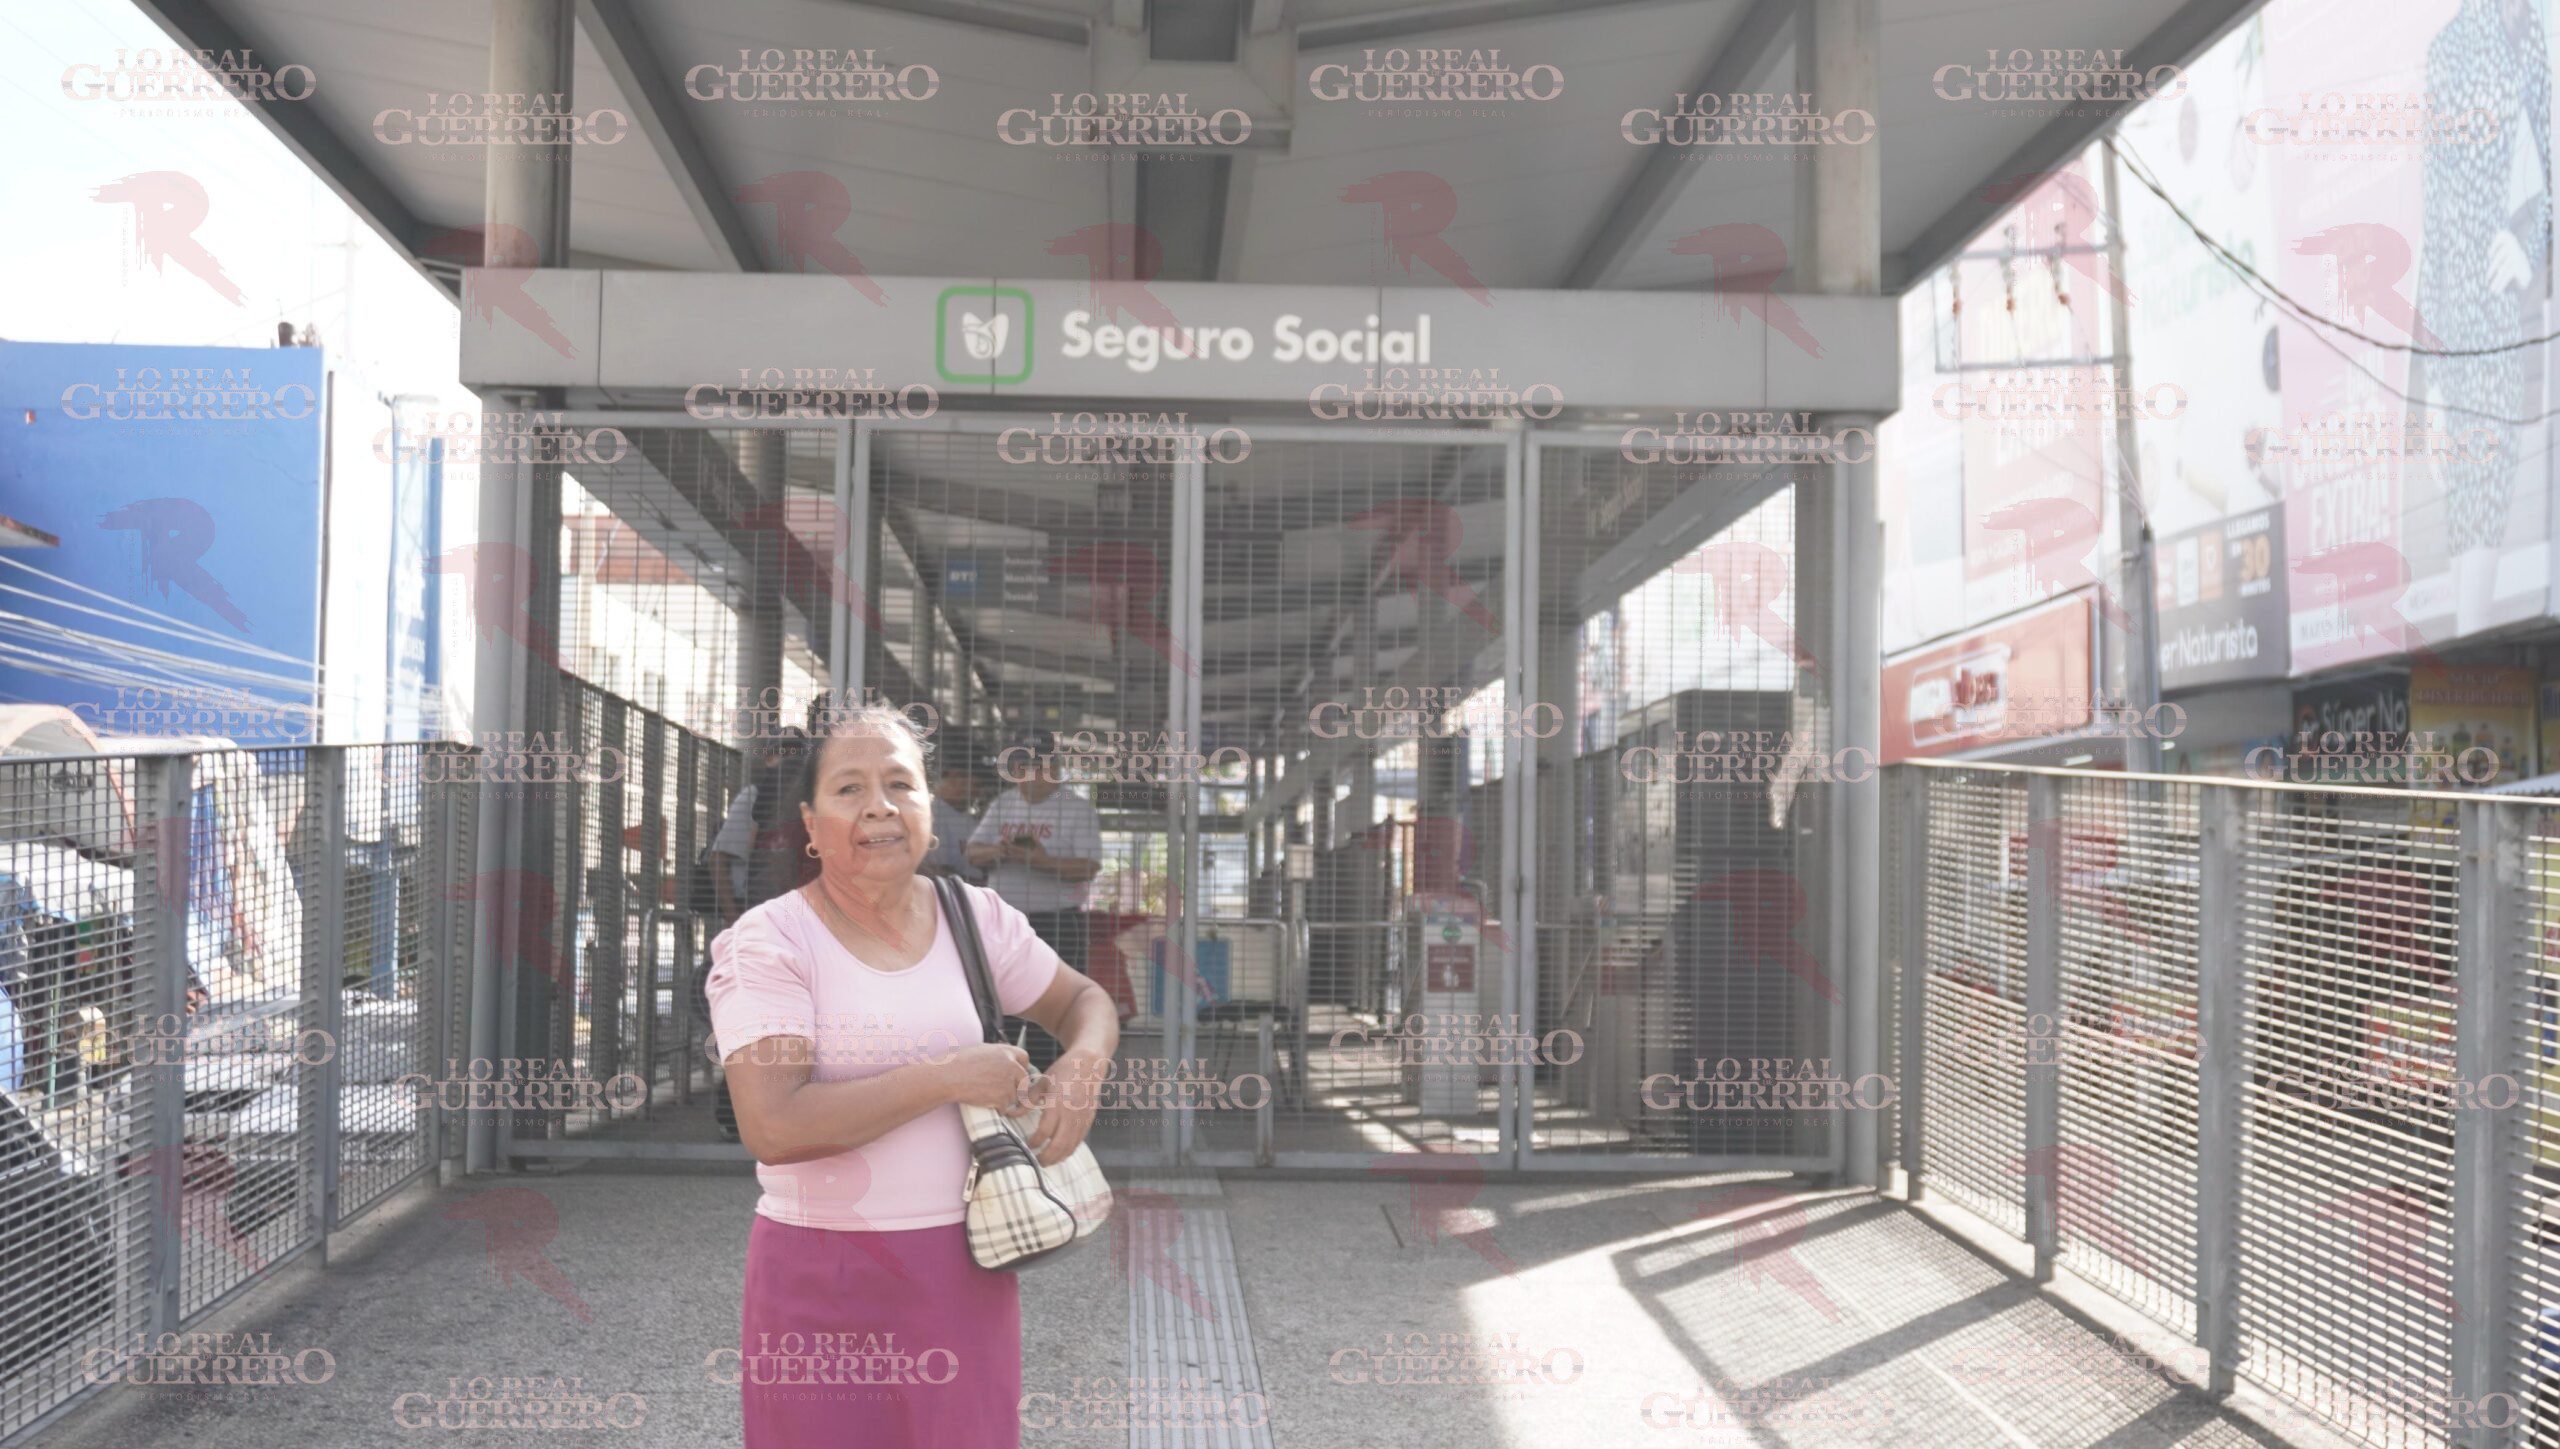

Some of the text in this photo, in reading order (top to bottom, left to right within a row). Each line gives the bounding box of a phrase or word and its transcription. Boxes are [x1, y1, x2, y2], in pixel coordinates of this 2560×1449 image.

[1061, 310, 1431, 372] Seguro Social
[2179, 617, 2258, 667] Naturista
